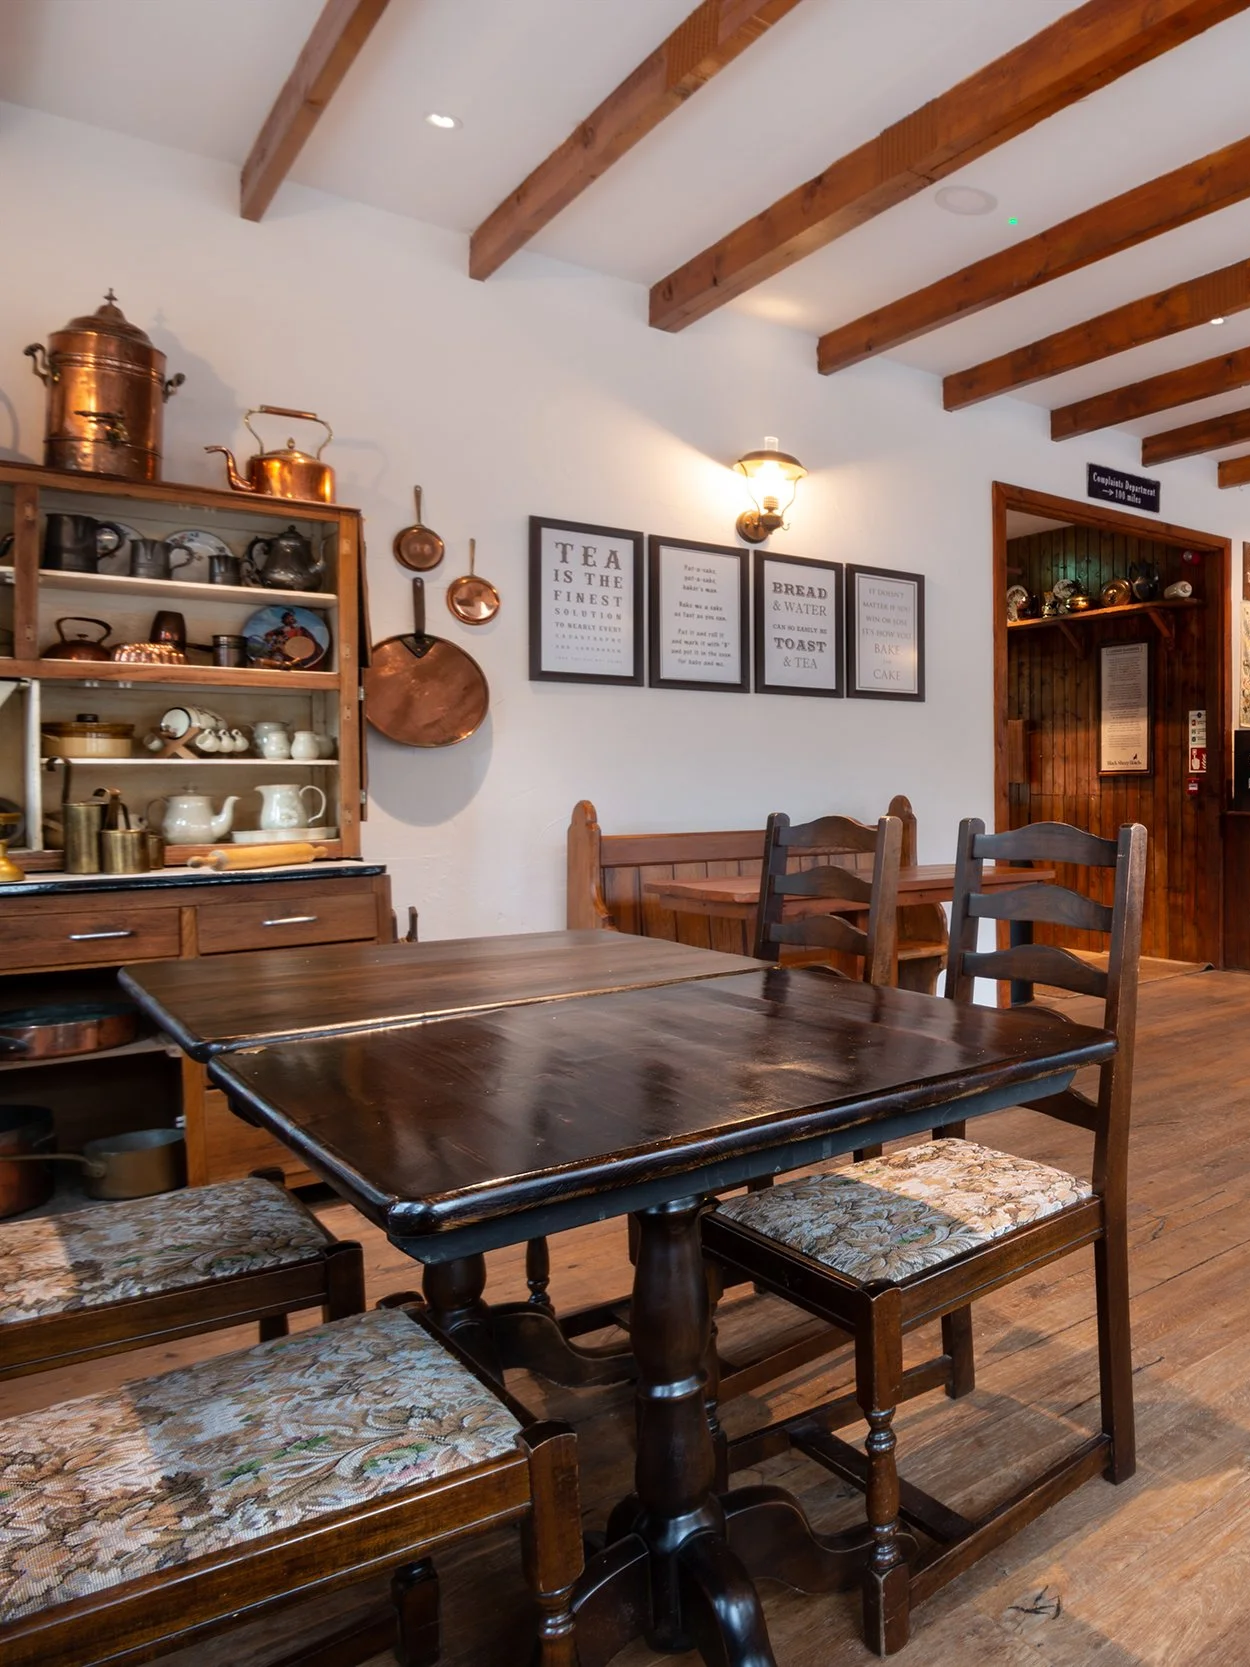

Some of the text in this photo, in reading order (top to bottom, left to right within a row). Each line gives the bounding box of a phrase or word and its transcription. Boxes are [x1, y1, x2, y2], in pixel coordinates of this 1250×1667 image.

[1092, 472, 1156, 496] Complaints Department
[1127, 494, 1141, 504] miles
[554, 542, 622, 570] TEA
[553, 568, 623, 589] IS THE
[772, 582, 827, 599] BREAD
[553, 590, 622, 607] FINEST
[772, 600, 827, 616] & WATER
[862, 601, 888, 610] MATTER
[554, 608, 621, 620] SOLUTION
[893, 618, 907, 626] LOSE
[876, 630, 894, 638] HOW
[897, 631, 912, 639] YOU
[774, 637, 827, 653] TOAST
[874, 643, 900, 655] BAKE
[783, 656, 818, 669] & TEA
[873, 669, 901, 680] CAKE
